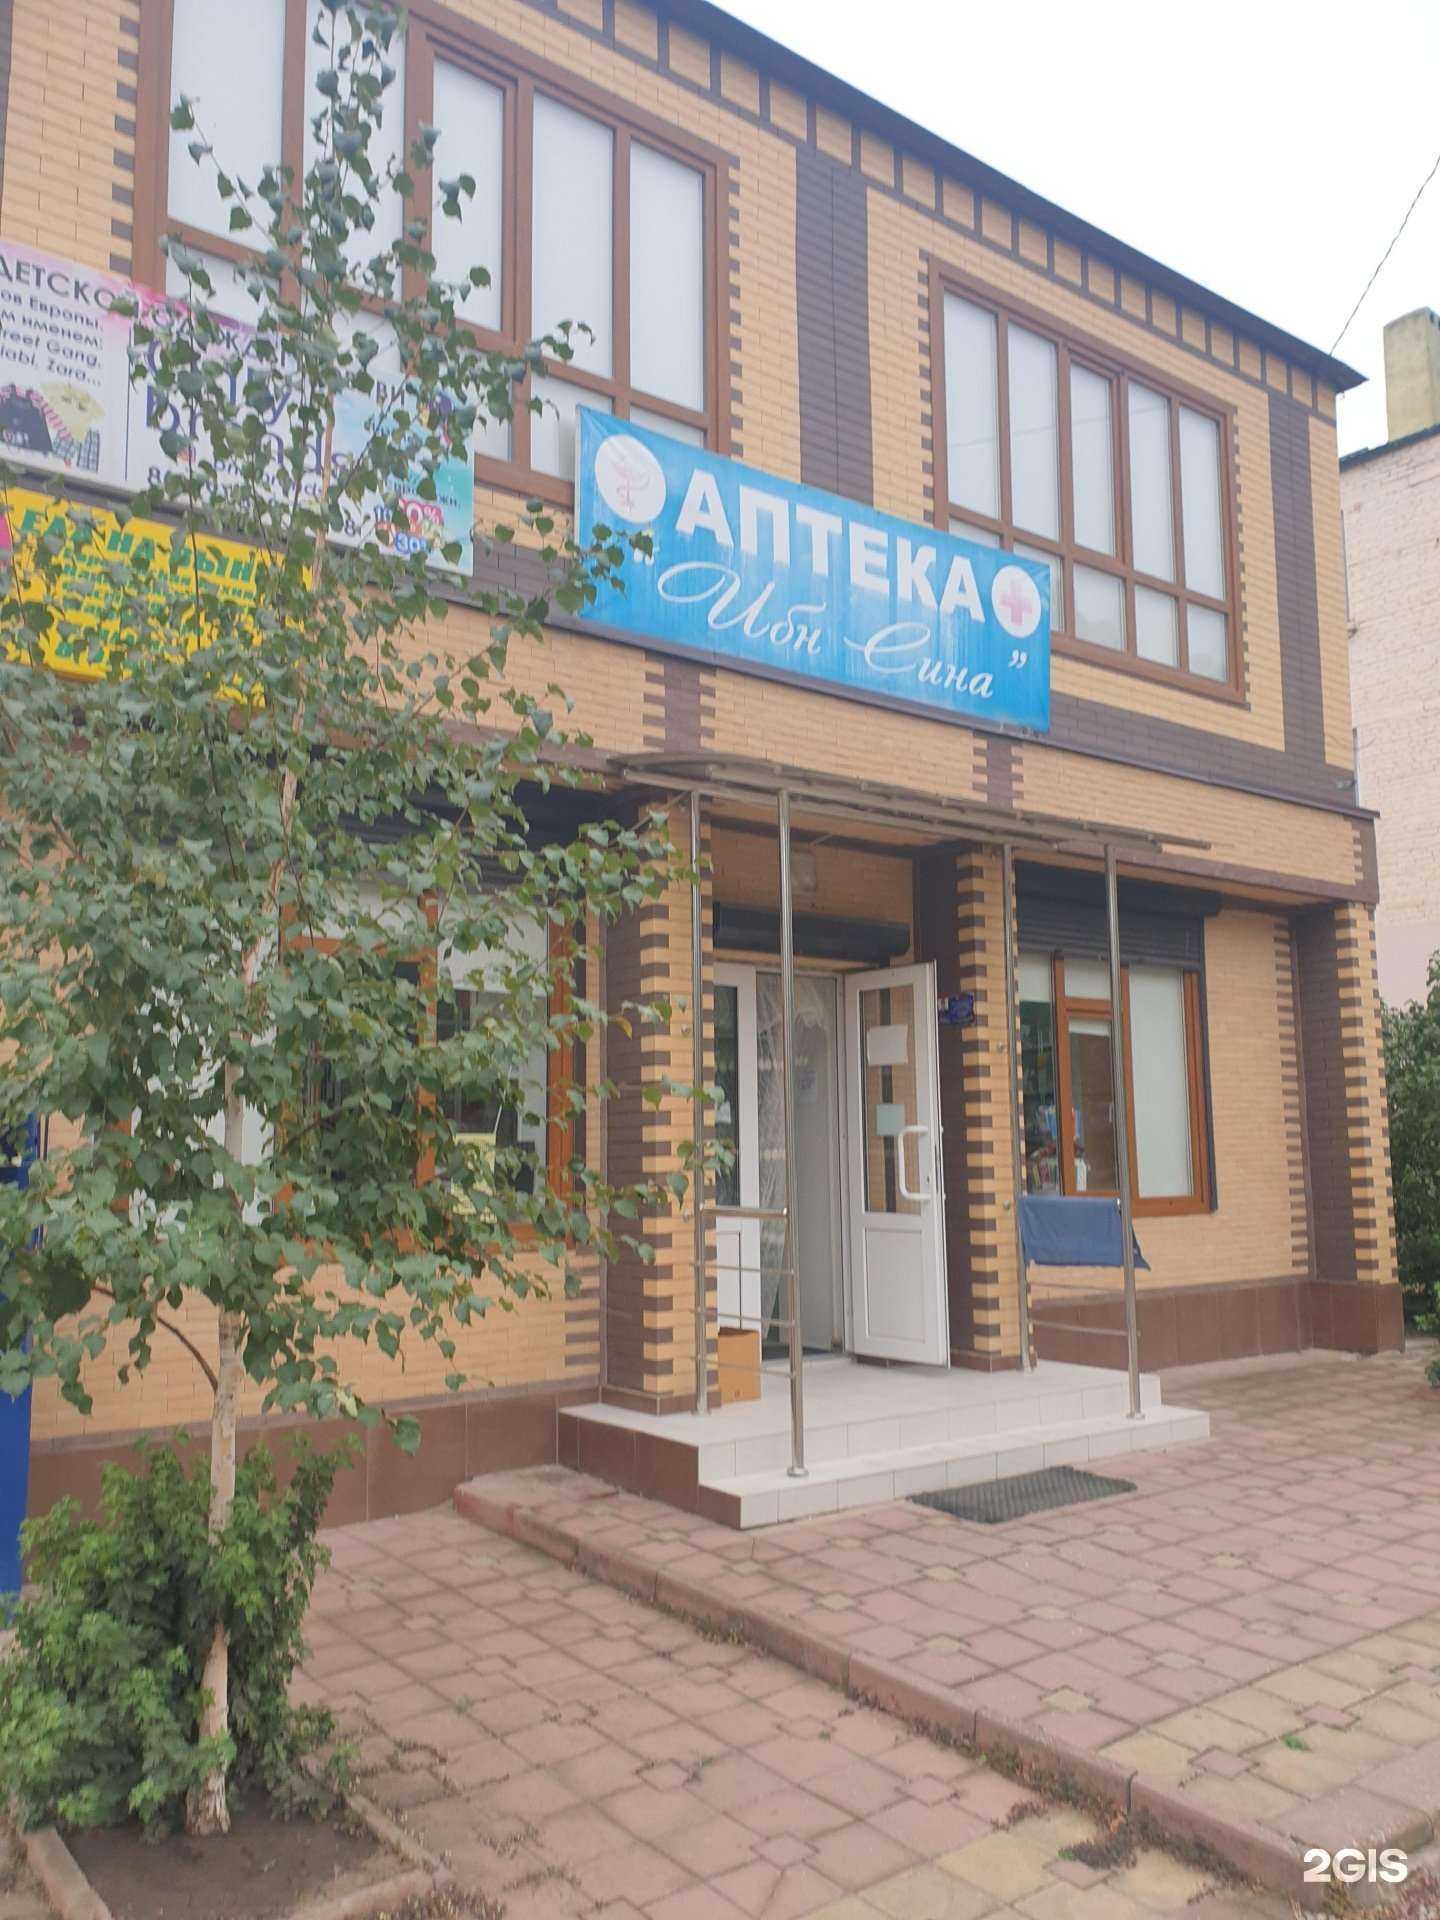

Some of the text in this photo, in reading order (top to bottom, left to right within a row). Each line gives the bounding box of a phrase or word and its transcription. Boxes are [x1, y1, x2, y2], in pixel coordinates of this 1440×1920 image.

[0, 254, 139, 318] ЕТСКО
[0, 328, 39, 349] reet
[676, 469, 985, 623] АПТЕКА
